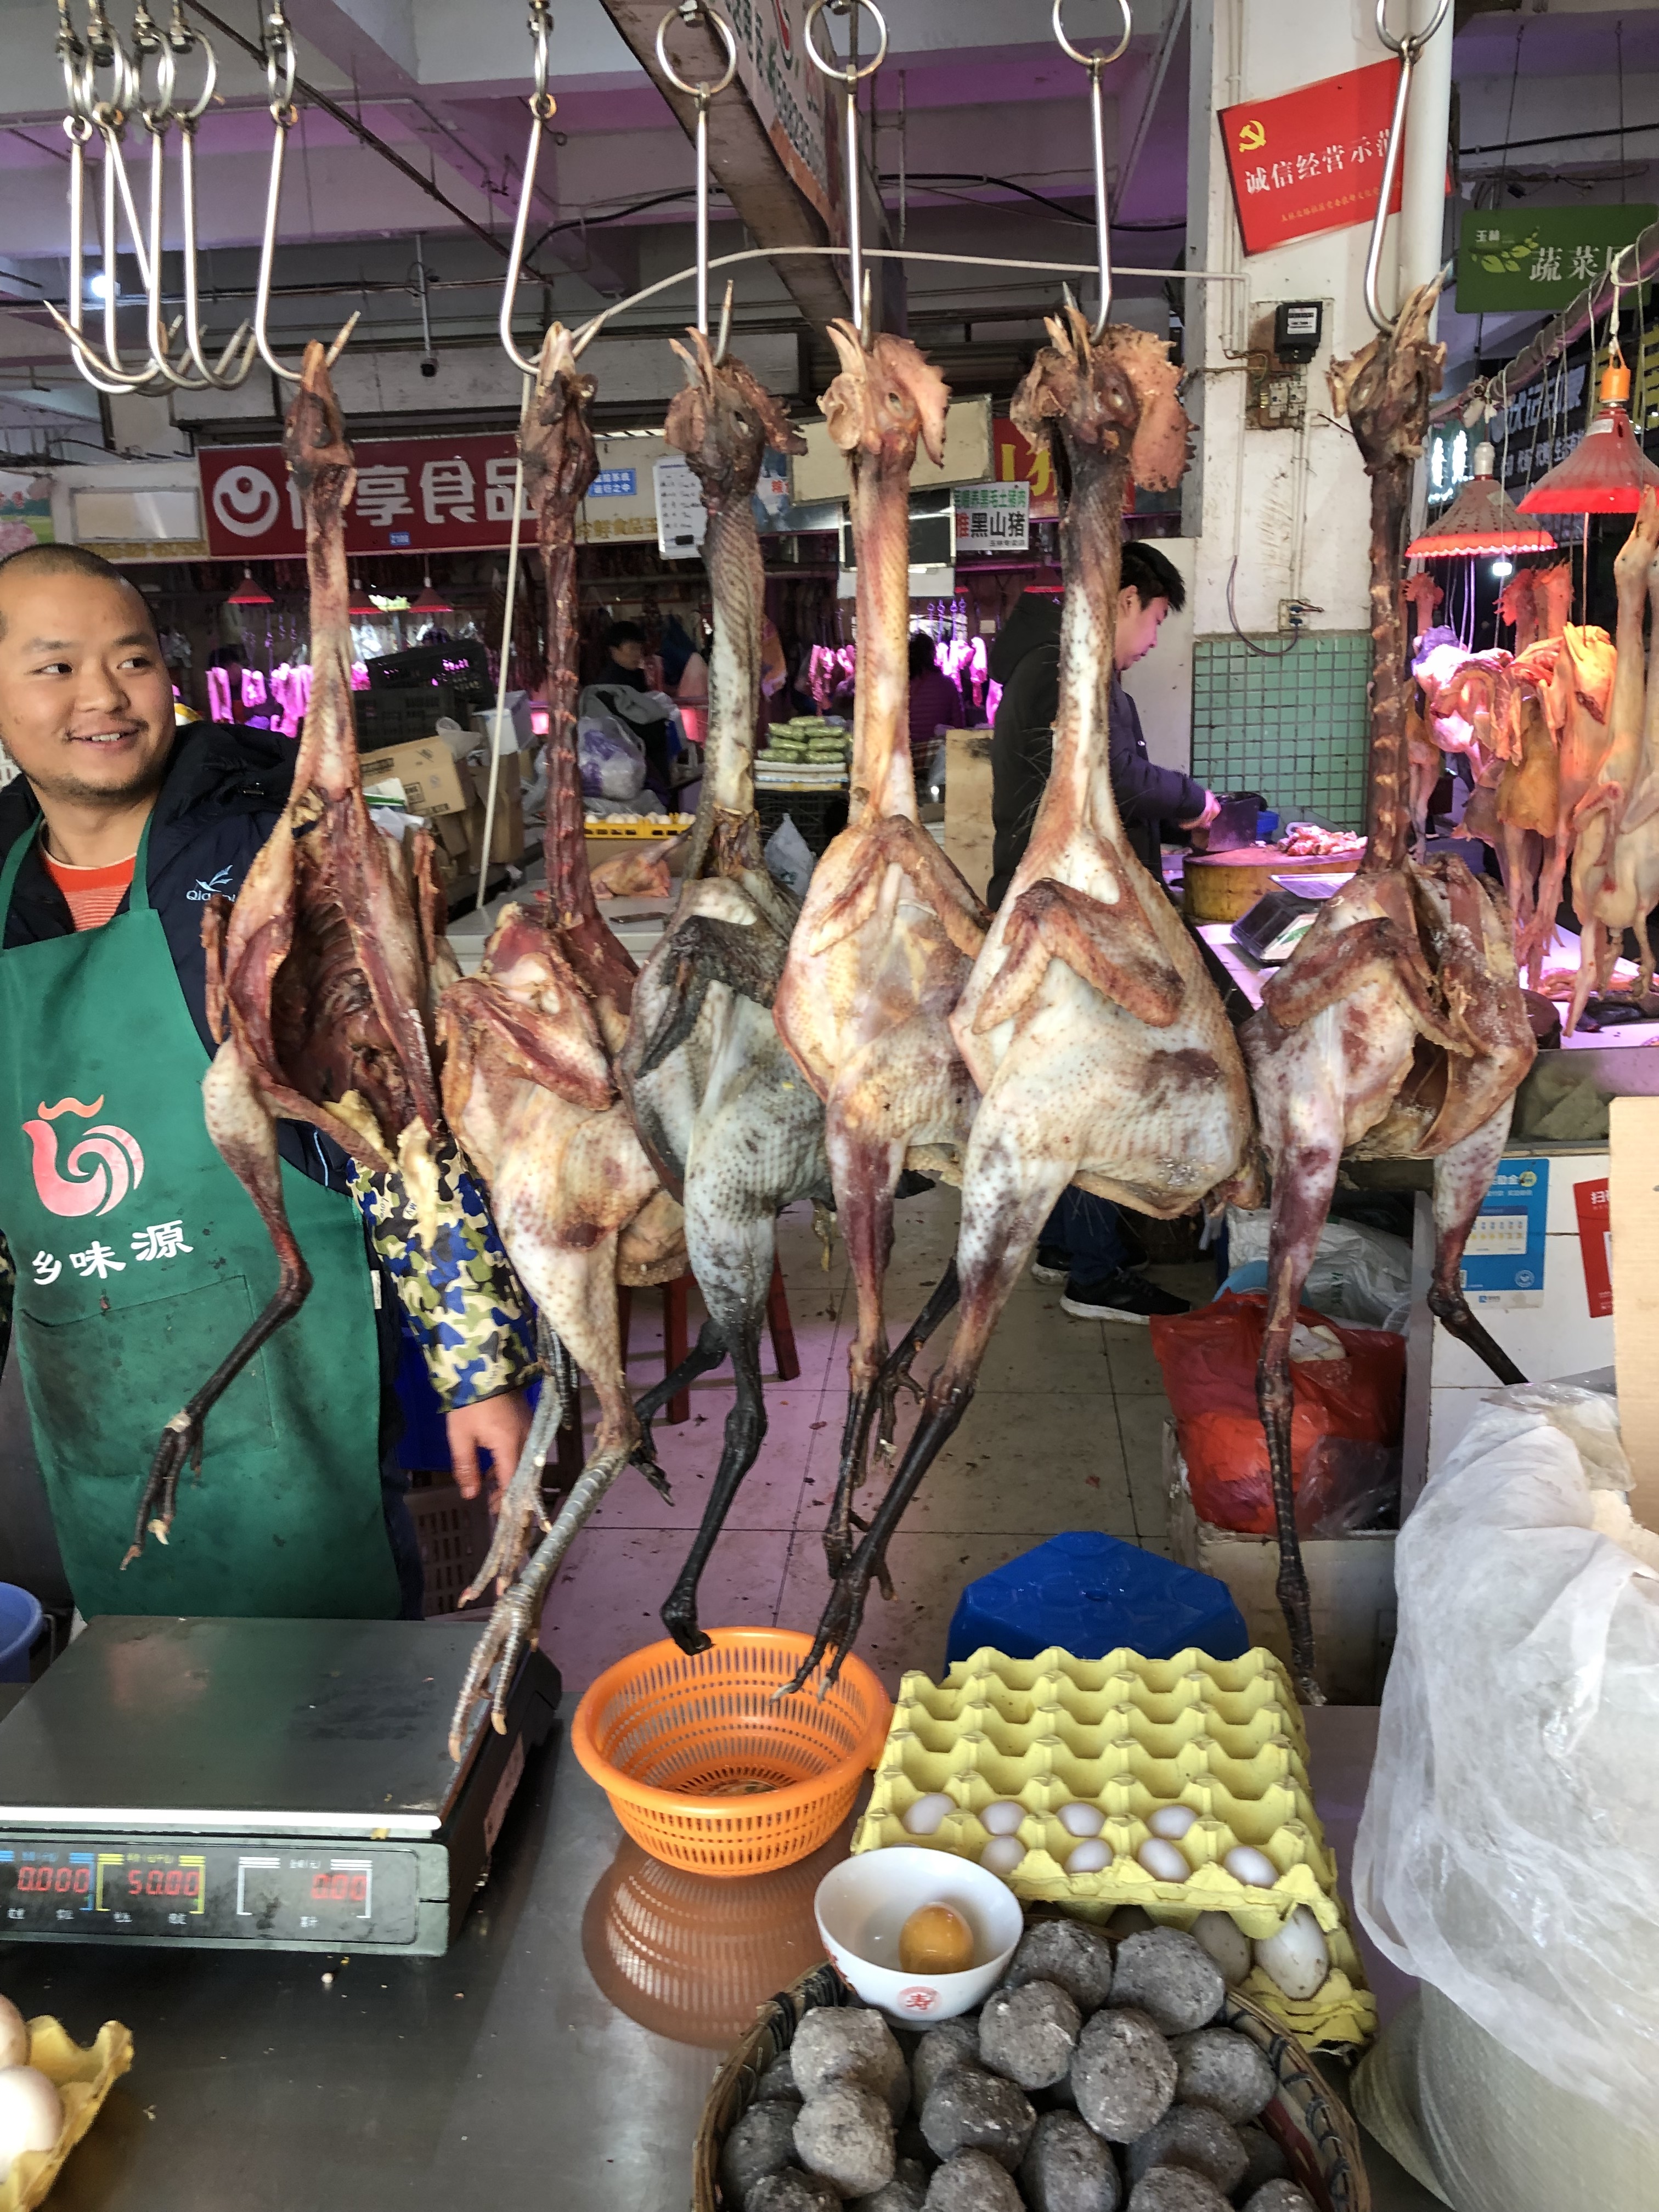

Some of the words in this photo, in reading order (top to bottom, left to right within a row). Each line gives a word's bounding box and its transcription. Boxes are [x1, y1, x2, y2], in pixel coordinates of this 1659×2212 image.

[286, 458, 539, 530] 享食品
[32, 1220, 194, 1285] 乡味源
